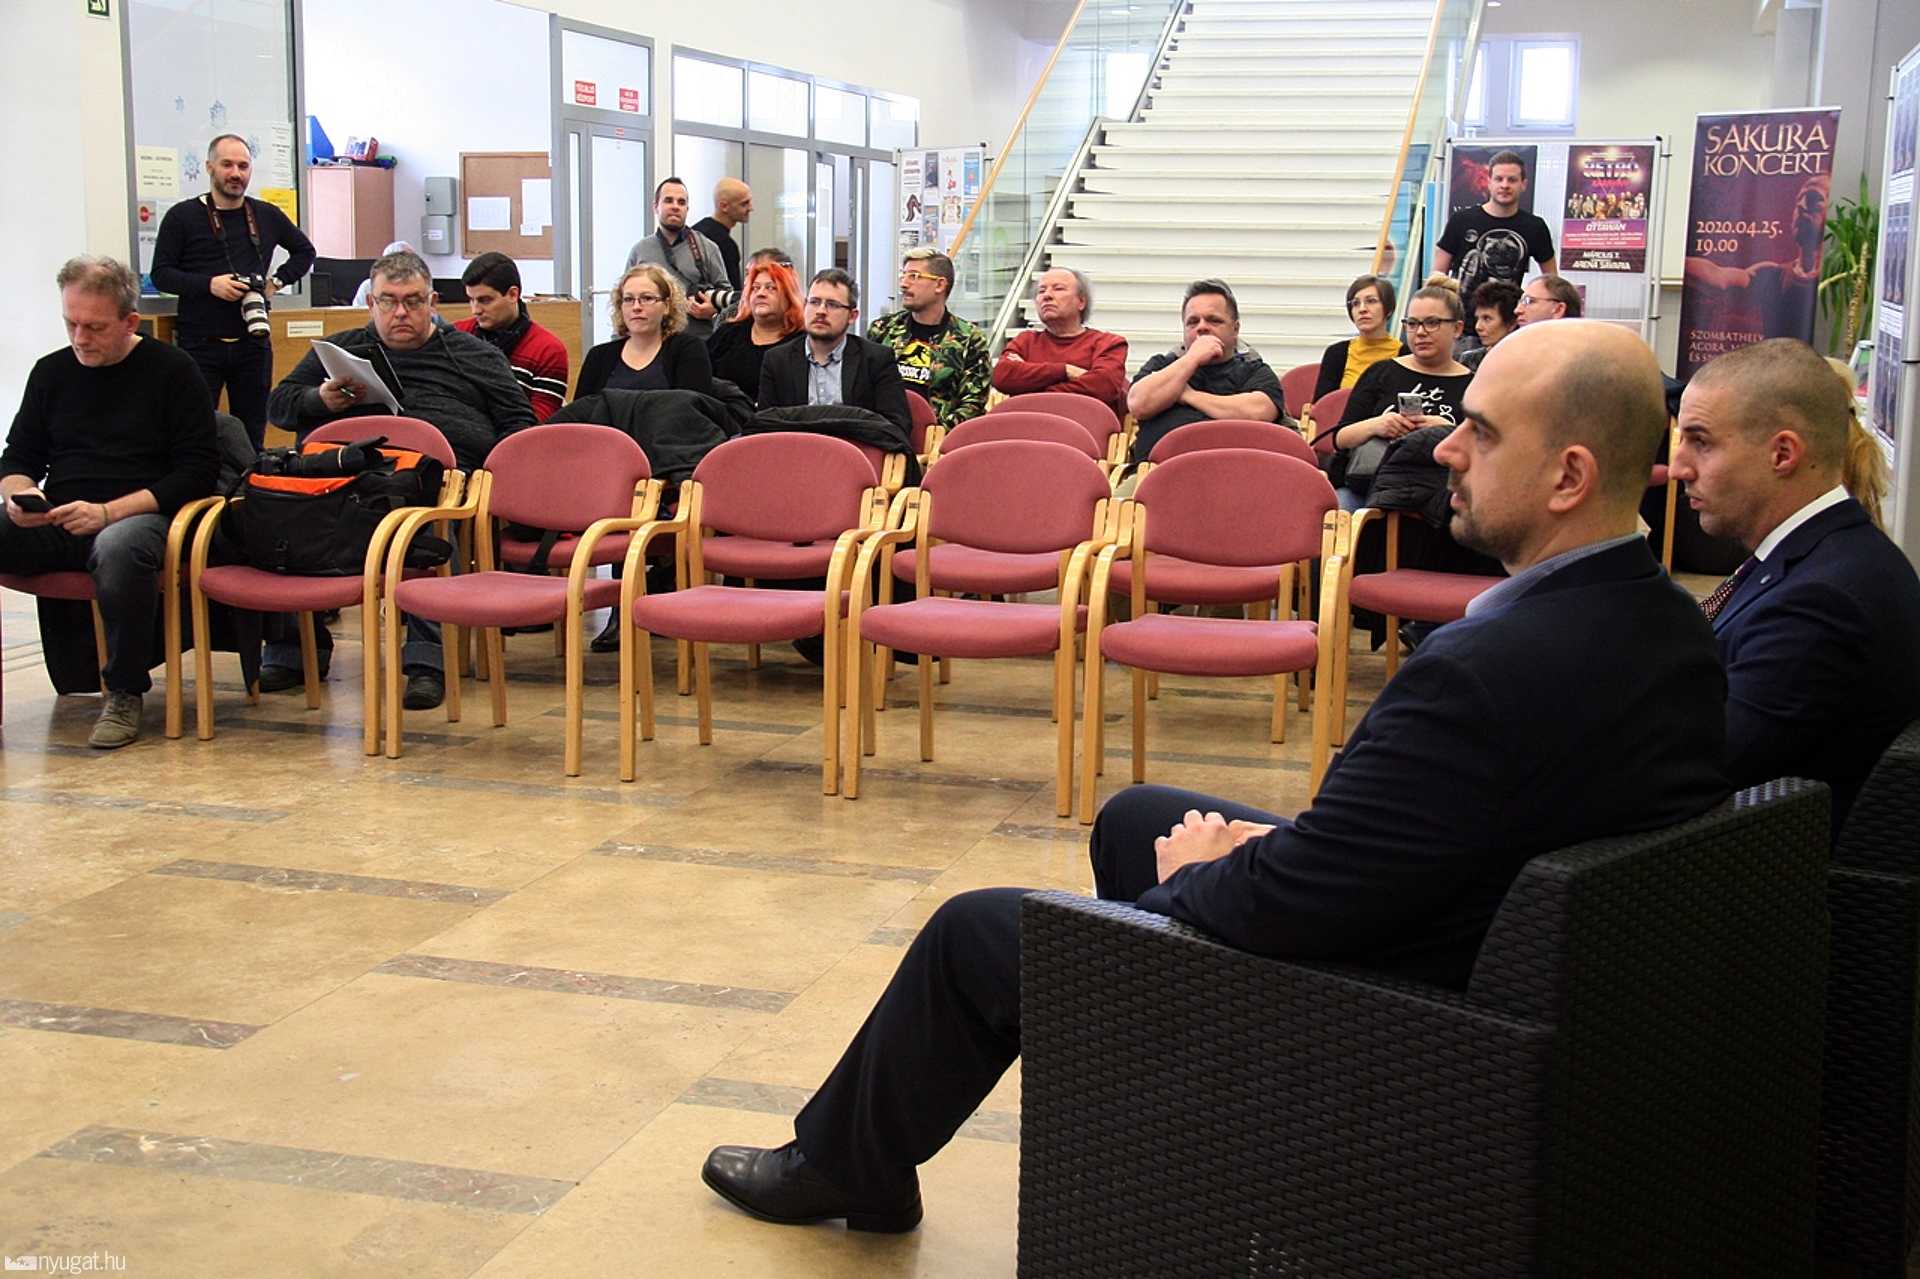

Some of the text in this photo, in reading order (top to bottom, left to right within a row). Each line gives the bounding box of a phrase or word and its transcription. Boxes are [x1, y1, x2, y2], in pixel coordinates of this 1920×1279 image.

[1705, 120, 1830, 154] SAKURA
[1704, 151, 1829, 178] KONCERT
[1696, 220, 1783, 239] 2020.04.25.
[1696, 239, 1738, 255] 19.00
